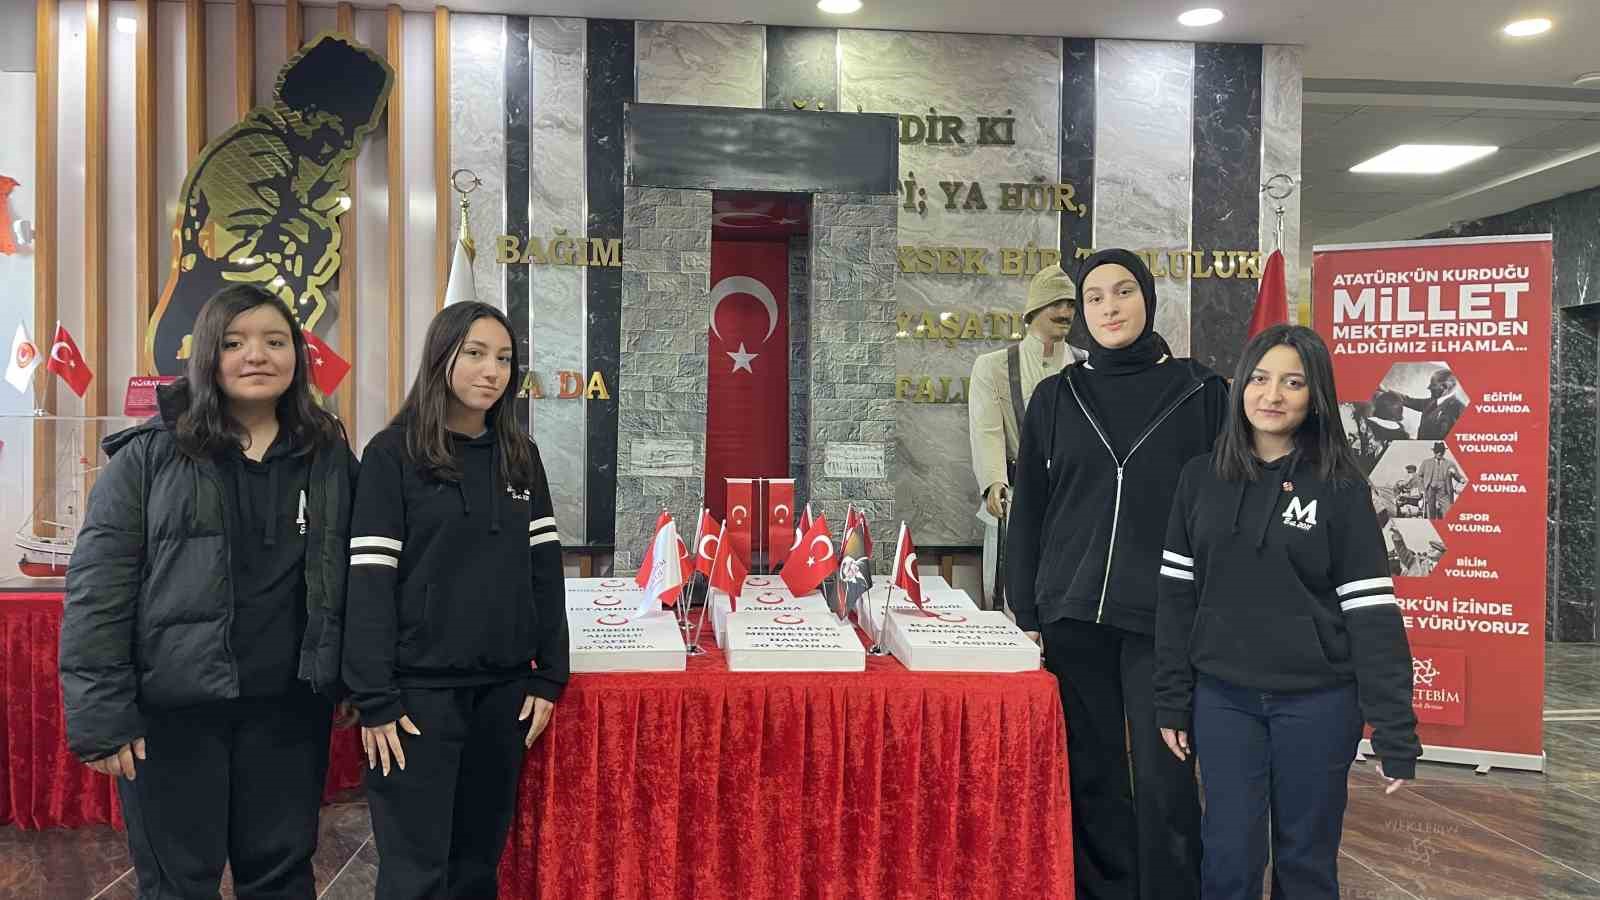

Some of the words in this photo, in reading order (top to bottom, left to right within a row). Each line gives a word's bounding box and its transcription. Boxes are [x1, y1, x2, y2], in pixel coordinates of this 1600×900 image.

[899, 107, 965, 145] DİR
[976, 109, 1015, 145] Kİ
[938, 181, 987, 210] YA
[999, 176, 1087, 218] HÜR,
[496, 225, 623, 267] BAĞIM
[897, 246, 989, 275] KSEK
[1333, 268, 1438, 286] ATATÜRK'ÜN
[1442, 264, 1529, 281] KURDUĞU
[1334, 340, 1426, 354] ALDIĞIMIZ
[517, 370, 544, 399] A
[557, 369, 611, 400] DA
[1483, 391, 1522, 402] EĞİTİM
[1475, 405, 1530, 413] YOLUNDA
[1459, 444, 1513, 453] YOLUNDA
[1480, 473, 1519, 482] SANAT
[1472, 484, 1527, 493] YOLUNDA
[1459, 513, 1489, 522] SPOR
[1447, 524, 1501, 533] YOLUNDA
[1456, 556, 1487, 568] BİLİM
[1444, 569, 1498, 579] YOLUNDA
[1396, 597, 1448, 613] RK'ÜN
[1452, 597, 1513, 616] İZİNDE
[1402, 616, 1413, 628] E
[1417, 614, 1529, 635] YÜRÜYORUZ
[1412, 688, 1460, 704] TEBİM
